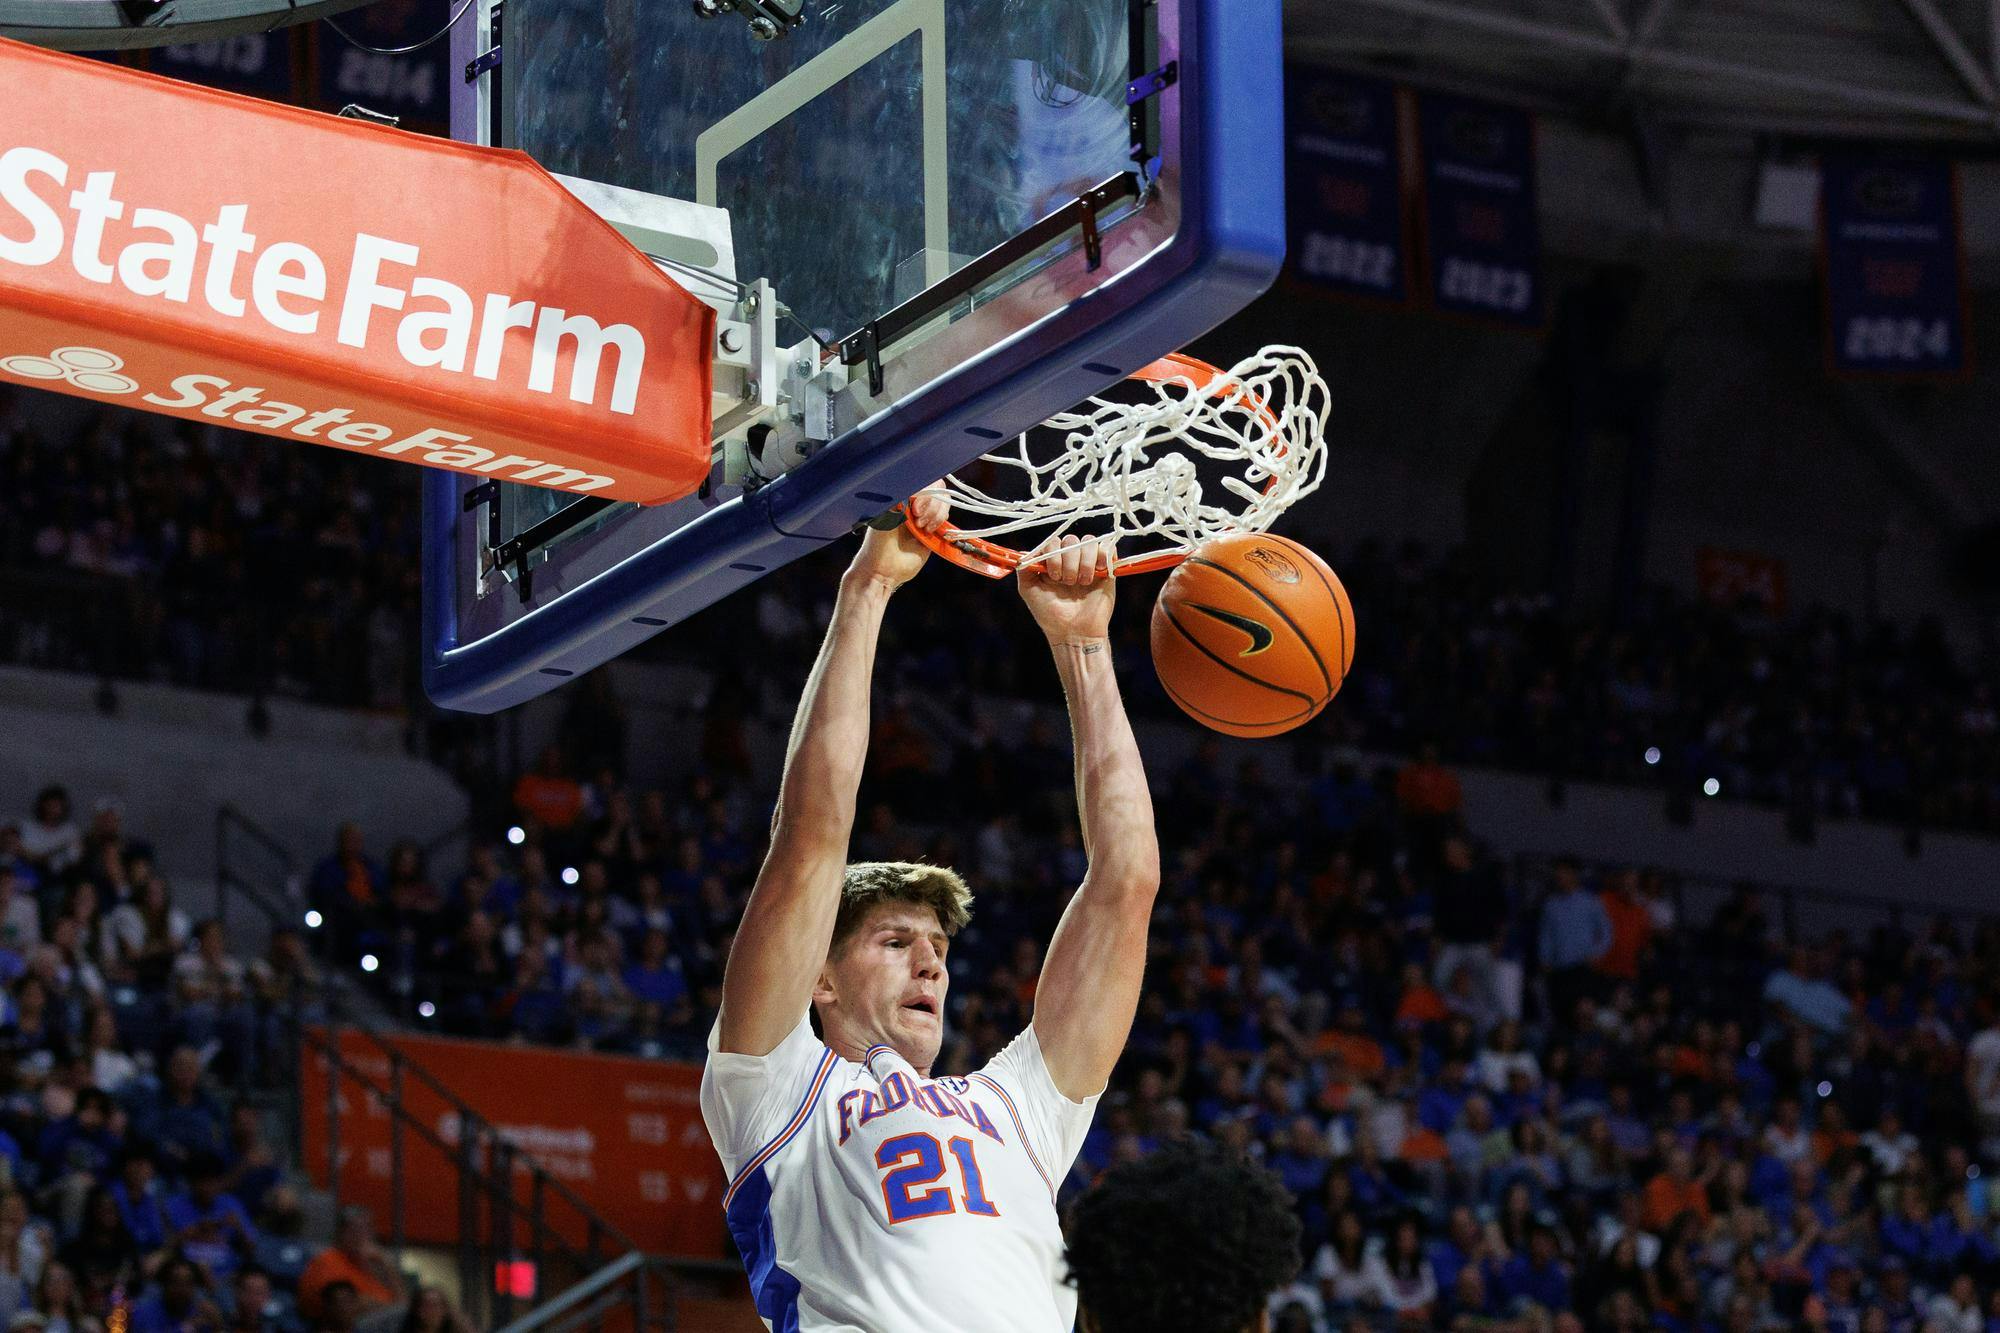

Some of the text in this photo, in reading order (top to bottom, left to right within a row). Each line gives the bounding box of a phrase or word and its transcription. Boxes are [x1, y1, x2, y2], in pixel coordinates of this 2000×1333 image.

[1845, 315, 1949, 362] 2024
[838, 1070, 1006, 1147] FLORIDA
[874, 1131, 1001, 1226] 21
